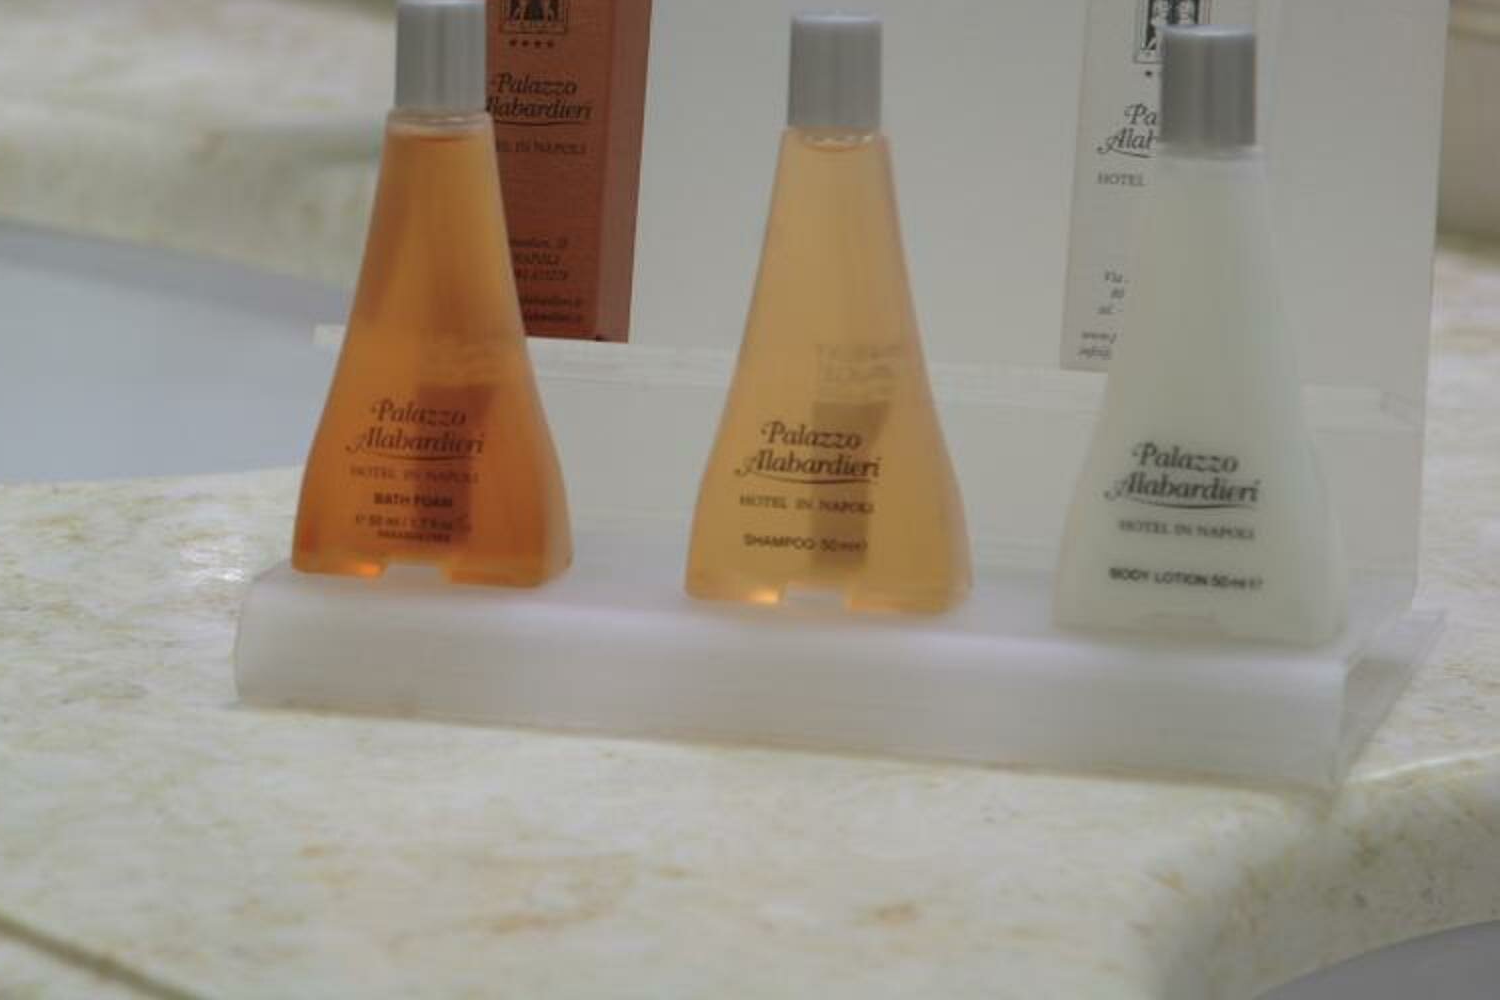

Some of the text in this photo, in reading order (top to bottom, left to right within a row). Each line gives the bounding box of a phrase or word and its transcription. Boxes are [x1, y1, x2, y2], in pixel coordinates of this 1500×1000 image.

[492, 71, 578, 96] Palazzo
[1097, 171, 1146, 187] HOTEL
[371, 397, 467, 428] Palazzo
[345, 427, 485, 457] Alabardieri
[761, 419, 863, 451] Palazzo
[735, 449, 883, 480] Alabardieri
[1132, 441, 1240, 474] Palazzo
[350, 465, 396, 480] HOTEL
[373, 491, 411, 505] BATH
[1103, 471, 1262, 504] Alabardieri
[740, 494, 875, 515] HOTEL IN NAPOLI
[743, 533, 816, 550] SHAMPOO
[1118, 519, 1257, 541] HOTEL IN NAPOLI
[1108, 566, 1150, 582] BODY
[1154, 570, 1208, 586] LOTION
